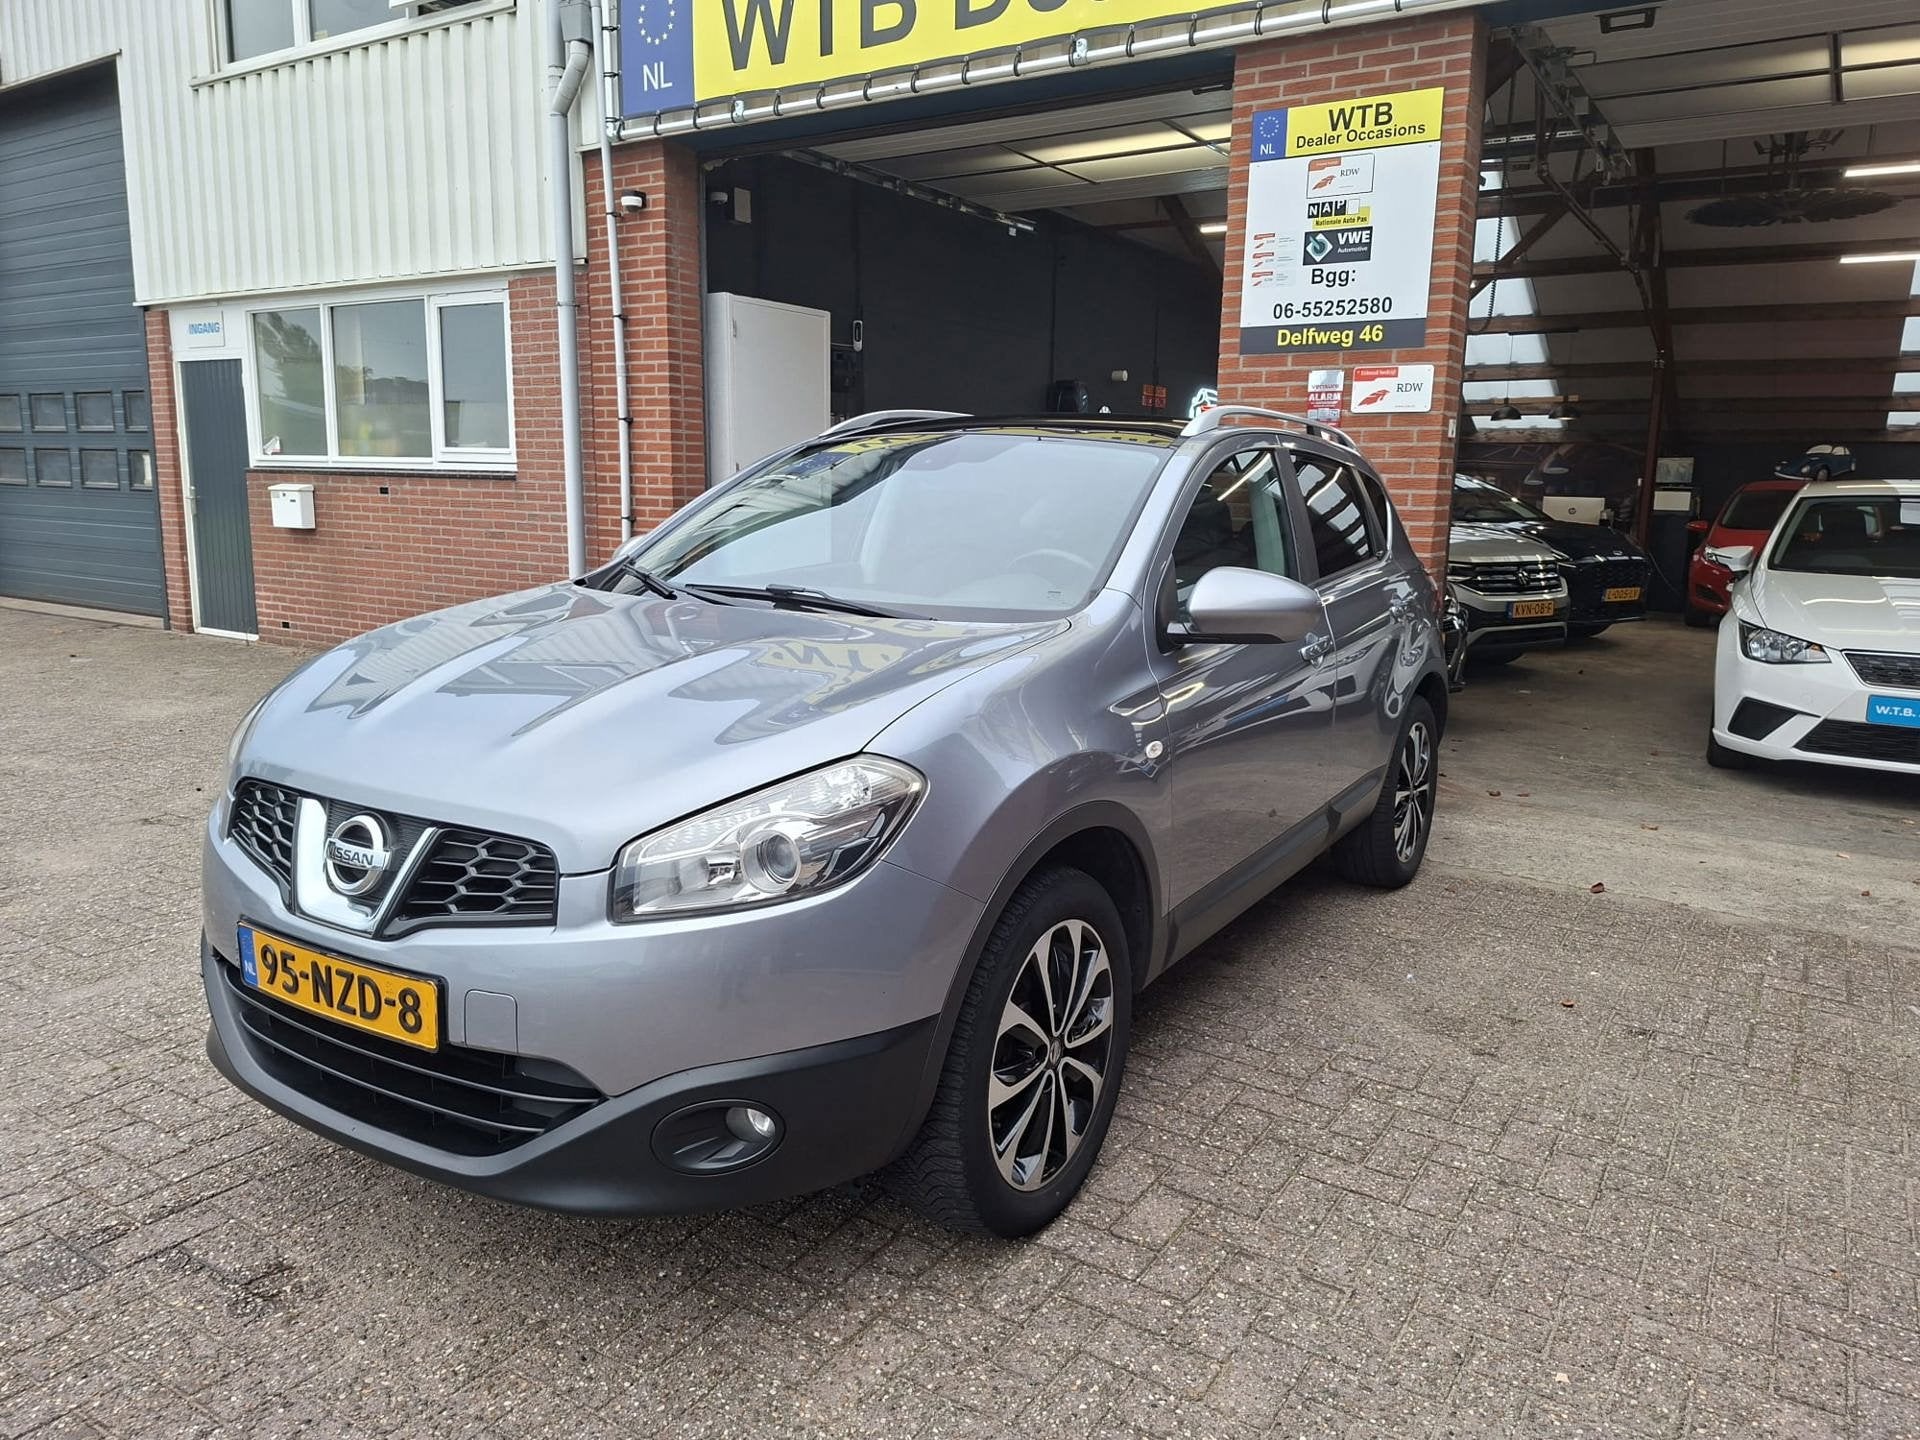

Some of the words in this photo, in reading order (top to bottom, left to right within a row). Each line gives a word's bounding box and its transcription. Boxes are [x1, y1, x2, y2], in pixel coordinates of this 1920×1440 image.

[643, 61, 673, 91] NL
[1328, 102, 1393, 132] WTB
[1296, 134, 1342, 149] Dealer
[1346, 124, 1426, 142] Occasions
[1260, 144, 1276, 156] NL
[1340, 167, 1360, 177] RDW
[1309, 200, 1345, 216] NAP
[1315, 217, 1341, 226] Nationale
[1343, 216, 1356, 224] Auto
[1337, 230, 1371, 245] VWE
[1311, 268, 1357, 288] Bgg:
[1273, 296, 1393, 320] 06-55252580
[189, 322, 220, 335] INGANG
[1277, 327, 1354, 348] Delfweg
[1359, 325, 1384, 343] 46
[1396, 382, 1424, 393] RDW
[1309, 392, 1341, 402] ALARM
[1875, 705, 1916, 717] W.T.B.
[328, 842, 373, 866] NISSAN
[261, 944, 423, 1033] 95-NZD-8
